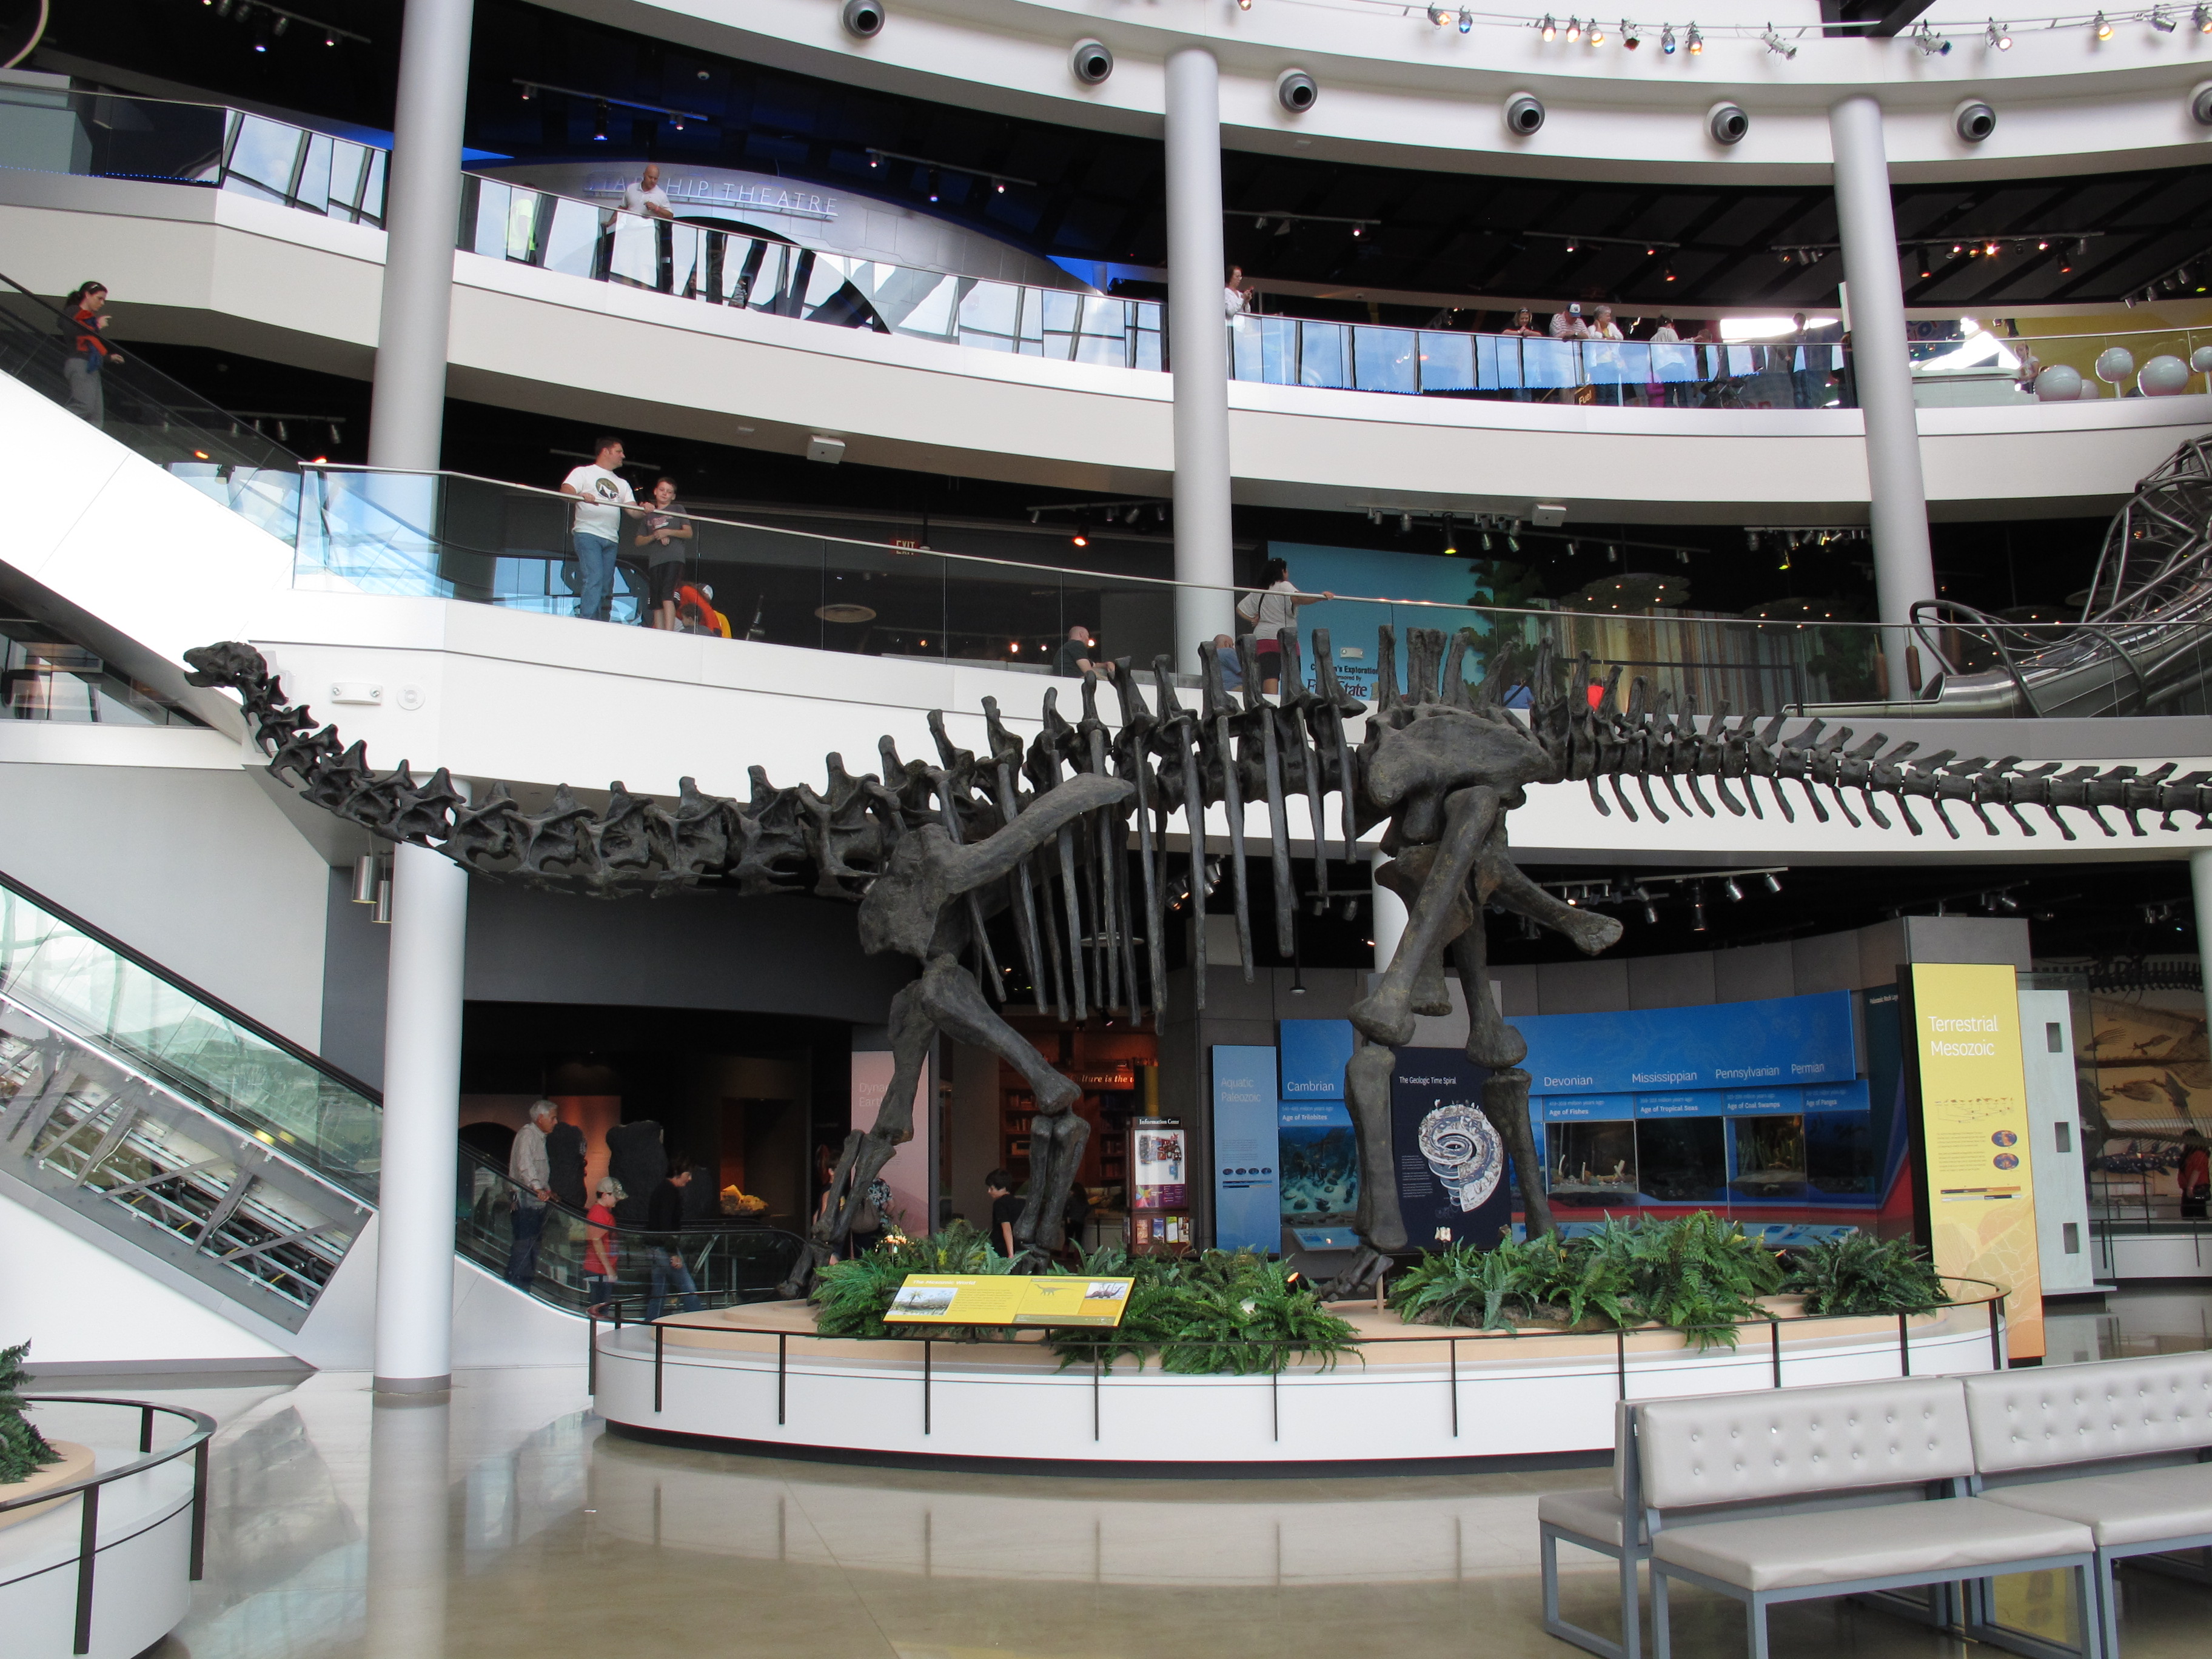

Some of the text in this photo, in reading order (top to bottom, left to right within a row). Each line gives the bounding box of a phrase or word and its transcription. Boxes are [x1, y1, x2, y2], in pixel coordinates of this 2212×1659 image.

[723, 183, 838, 213] THEATRE
[1578, 390, 1592, 404] Fuel
[896, 540, 915, 555] EXIT
[1928, 1014, 1999, 1032] Terrestrial
[1931, 1039, 1994, 1056] Mesozoic
[1715, 1065, 1780, 1081] Pennsylvanian
[1791, 1062, 1825, 1074] Permian
[1114, 1074, 1128, 1083] the
[1221, 1078, 1254, 1089] Aquatic
[1409, 1076, 1430, 1086] Geologic
[1443, 1077, 1456, 1085] Spiral
[1544, 1075, 1593, 1087] Devonian
[1632, 1070, 1697, 1084] Mississippian
[859, 1082, 890, 1095] Dyna
[1287, 1081, 1335, 1092] Cambrian
[1221, 1091, 1262, 1102] Paleozoic
